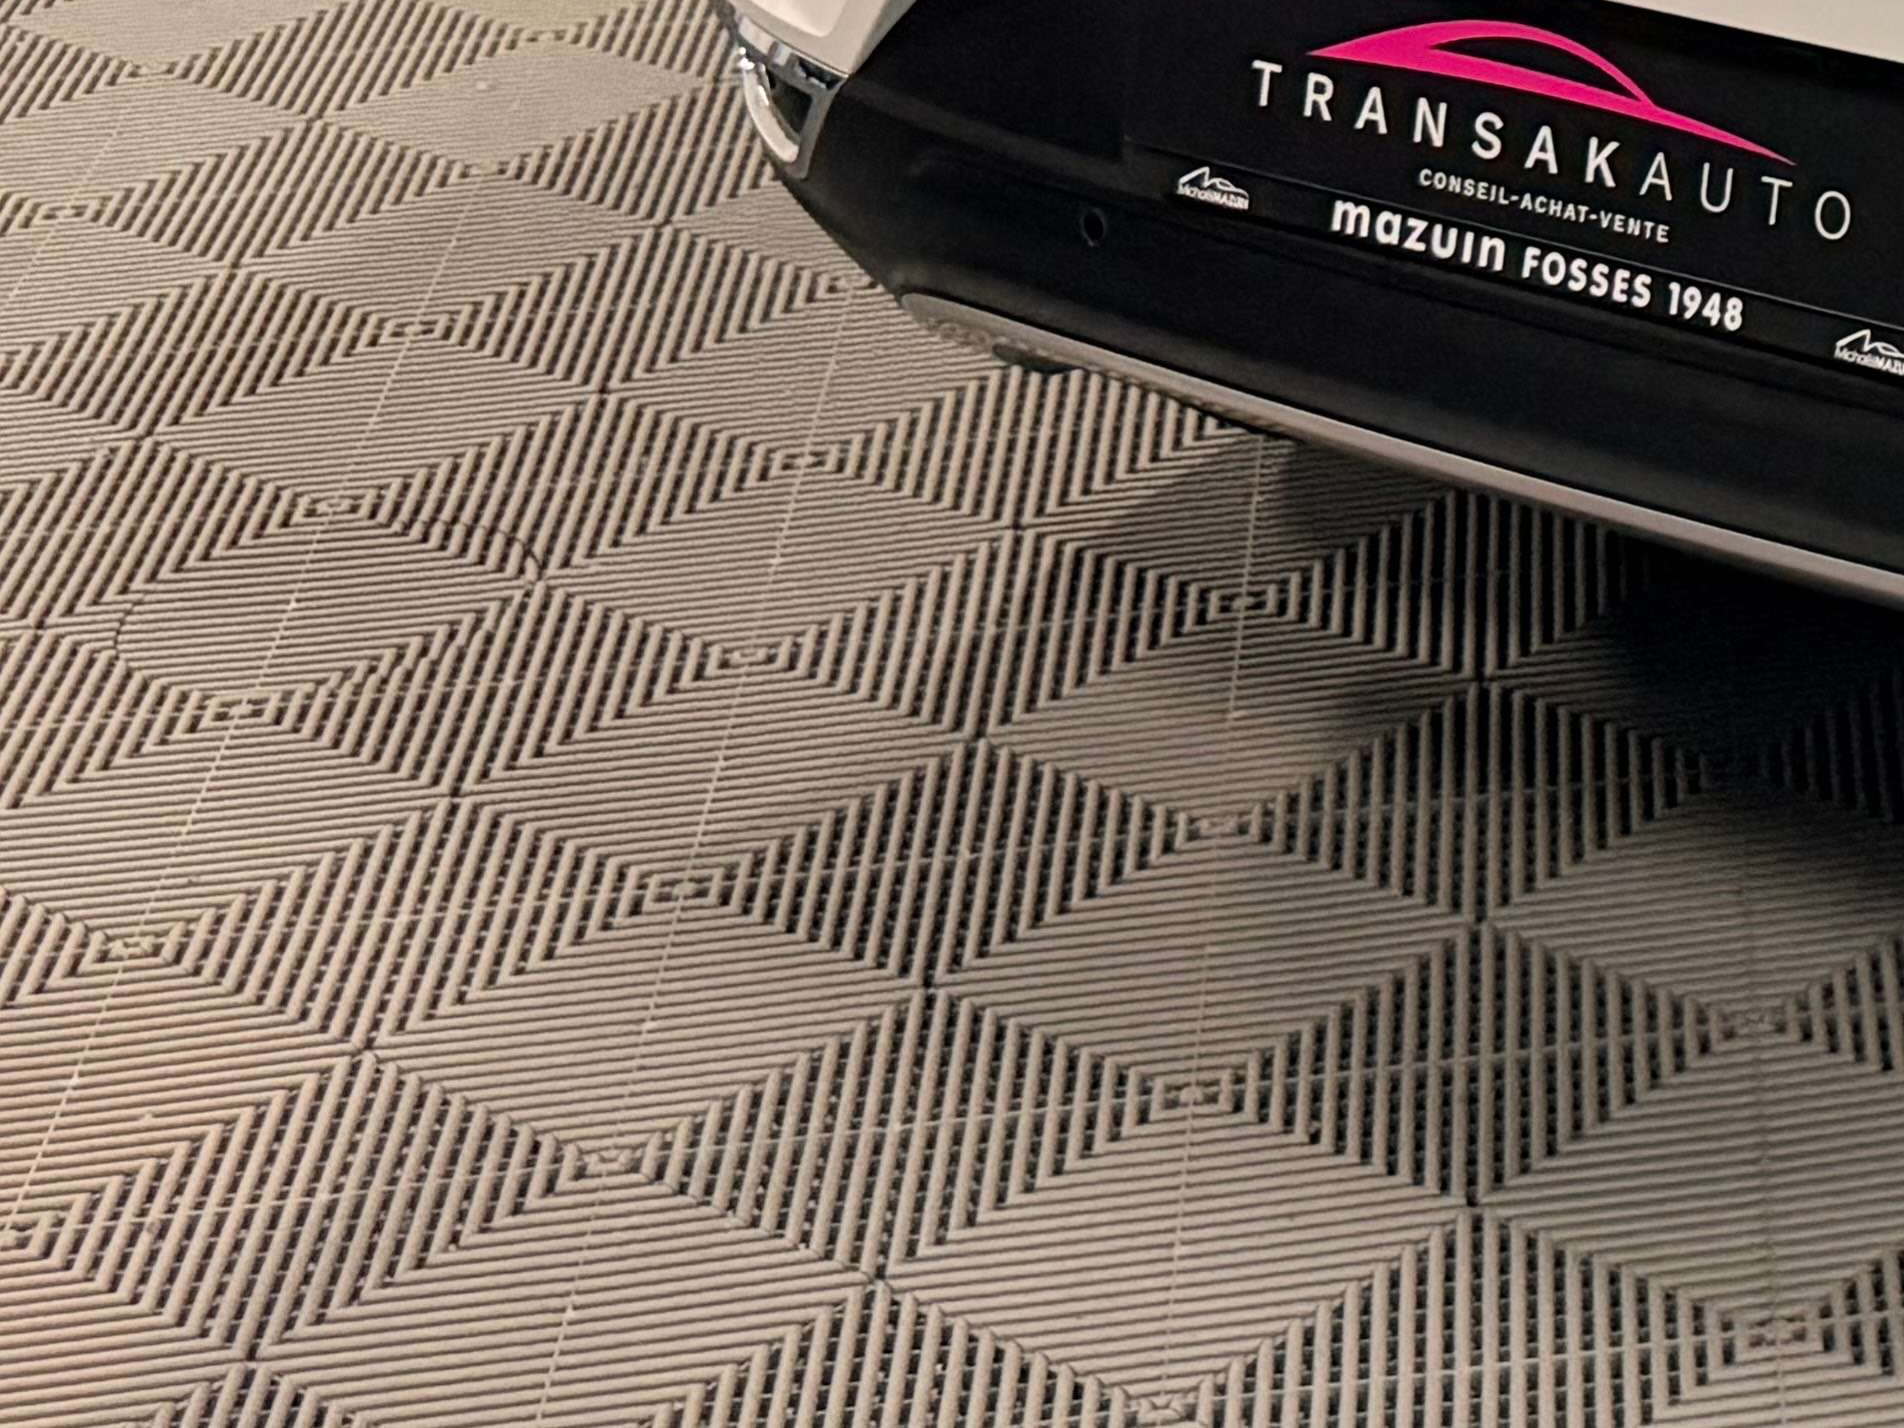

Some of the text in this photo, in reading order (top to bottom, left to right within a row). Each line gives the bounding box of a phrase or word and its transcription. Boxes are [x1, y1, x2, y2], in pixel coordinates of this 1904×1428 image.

[1251, 58, 1852, 241] TRANSAKAUTO
[1419, 167, 1670, 244] CONSEIL-ACHAT-VENTE
[1332, 199, 1744, 333] mazuin FOSSES 1948
